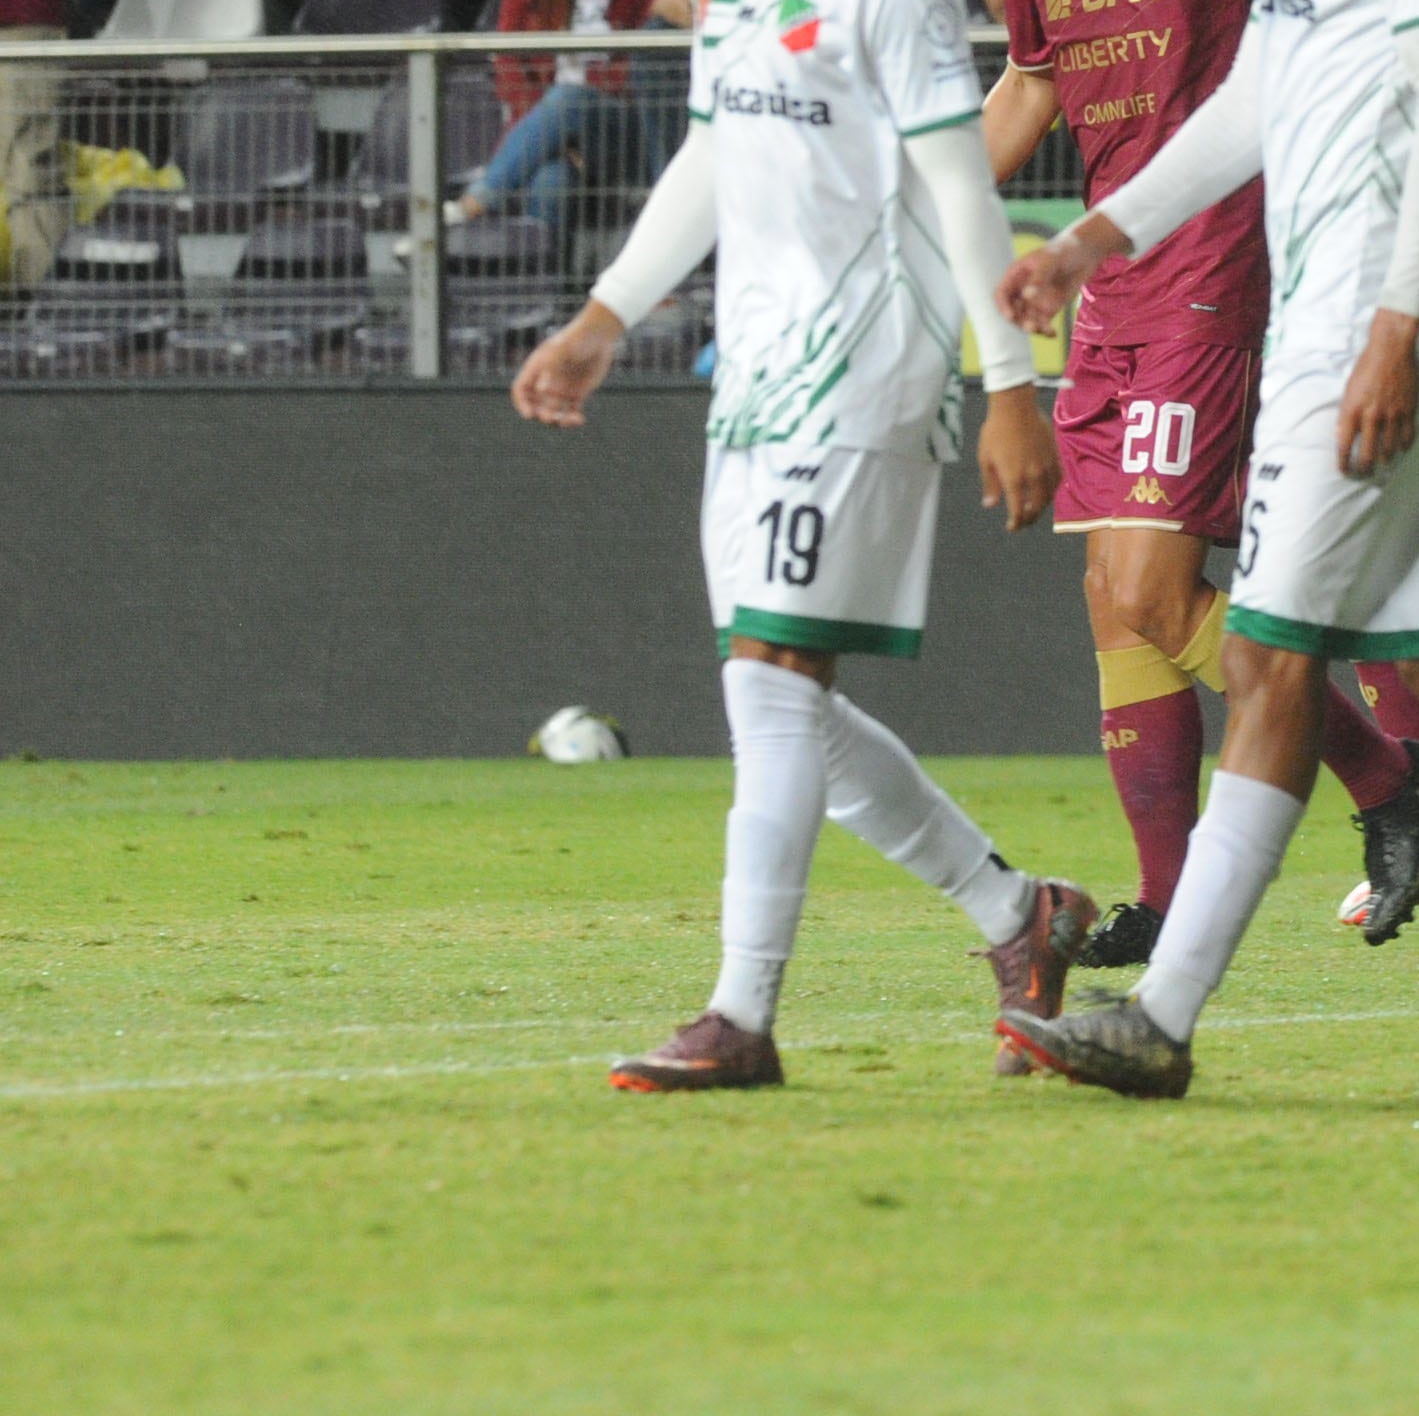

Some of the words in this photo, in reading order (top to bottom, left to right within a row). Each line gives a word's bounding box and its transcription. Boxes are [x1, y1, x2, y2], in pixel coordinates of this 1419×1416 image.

[1058, 27, 1173, 73] LIBERTY
[1122, 399, 1196, 477] 20
[757, 499, 825, 588] 19
